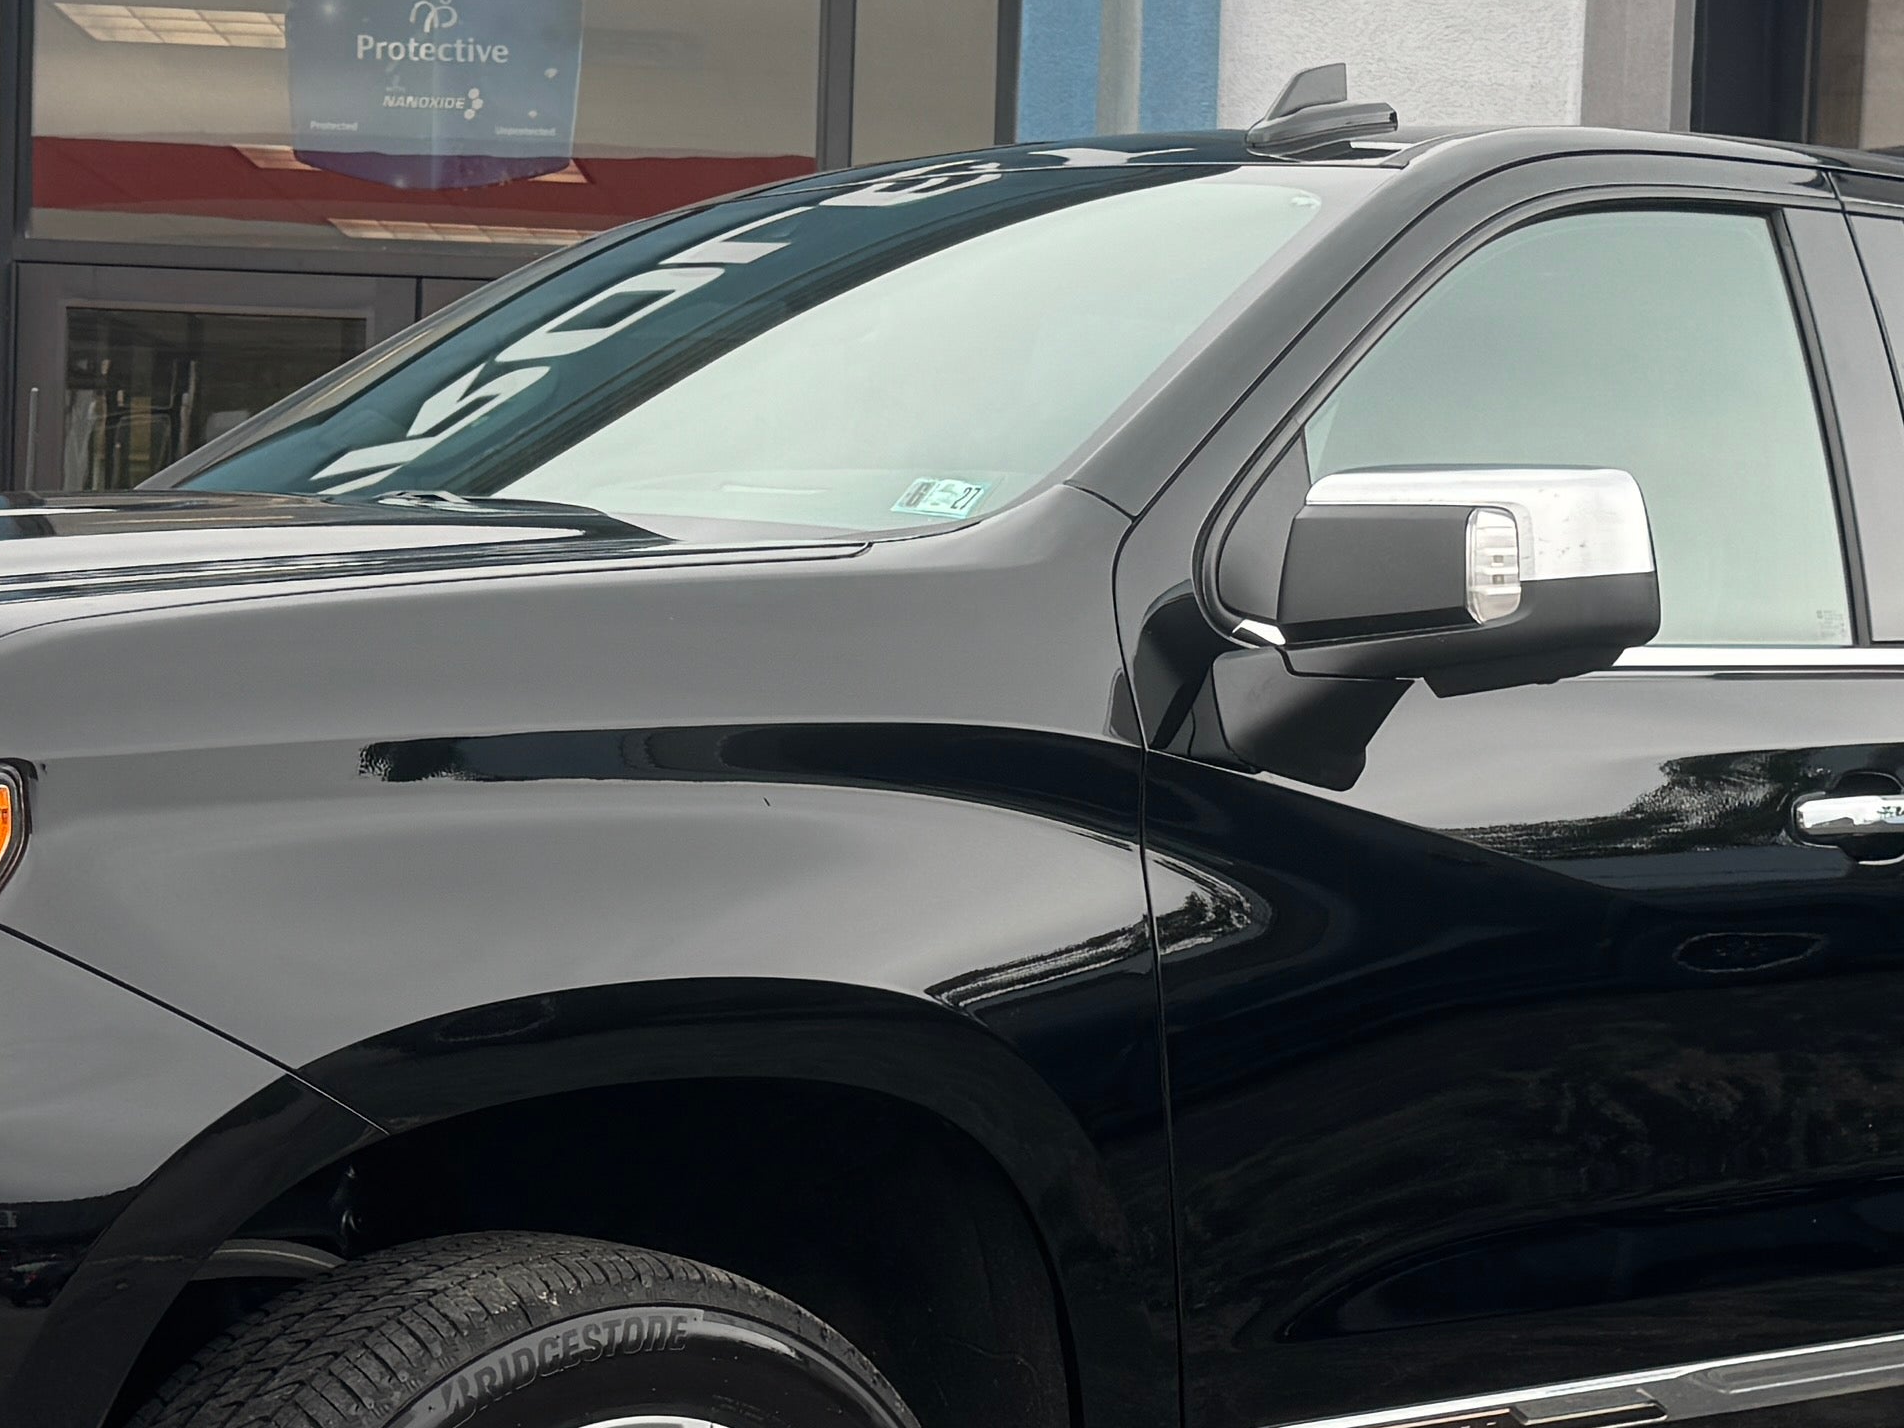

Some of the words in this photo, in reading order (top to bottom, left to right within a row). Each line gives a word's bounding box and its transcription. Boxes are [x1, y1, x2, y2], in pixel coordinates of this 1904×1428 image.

[356, 34, 510, 64] Protective
[382, 94, 466, 110] NANOXIDE
[309, 119, 358, 132] Protected
[494, 124, 556, 138] Unprotected
[950, 487, 982, 510] 27
